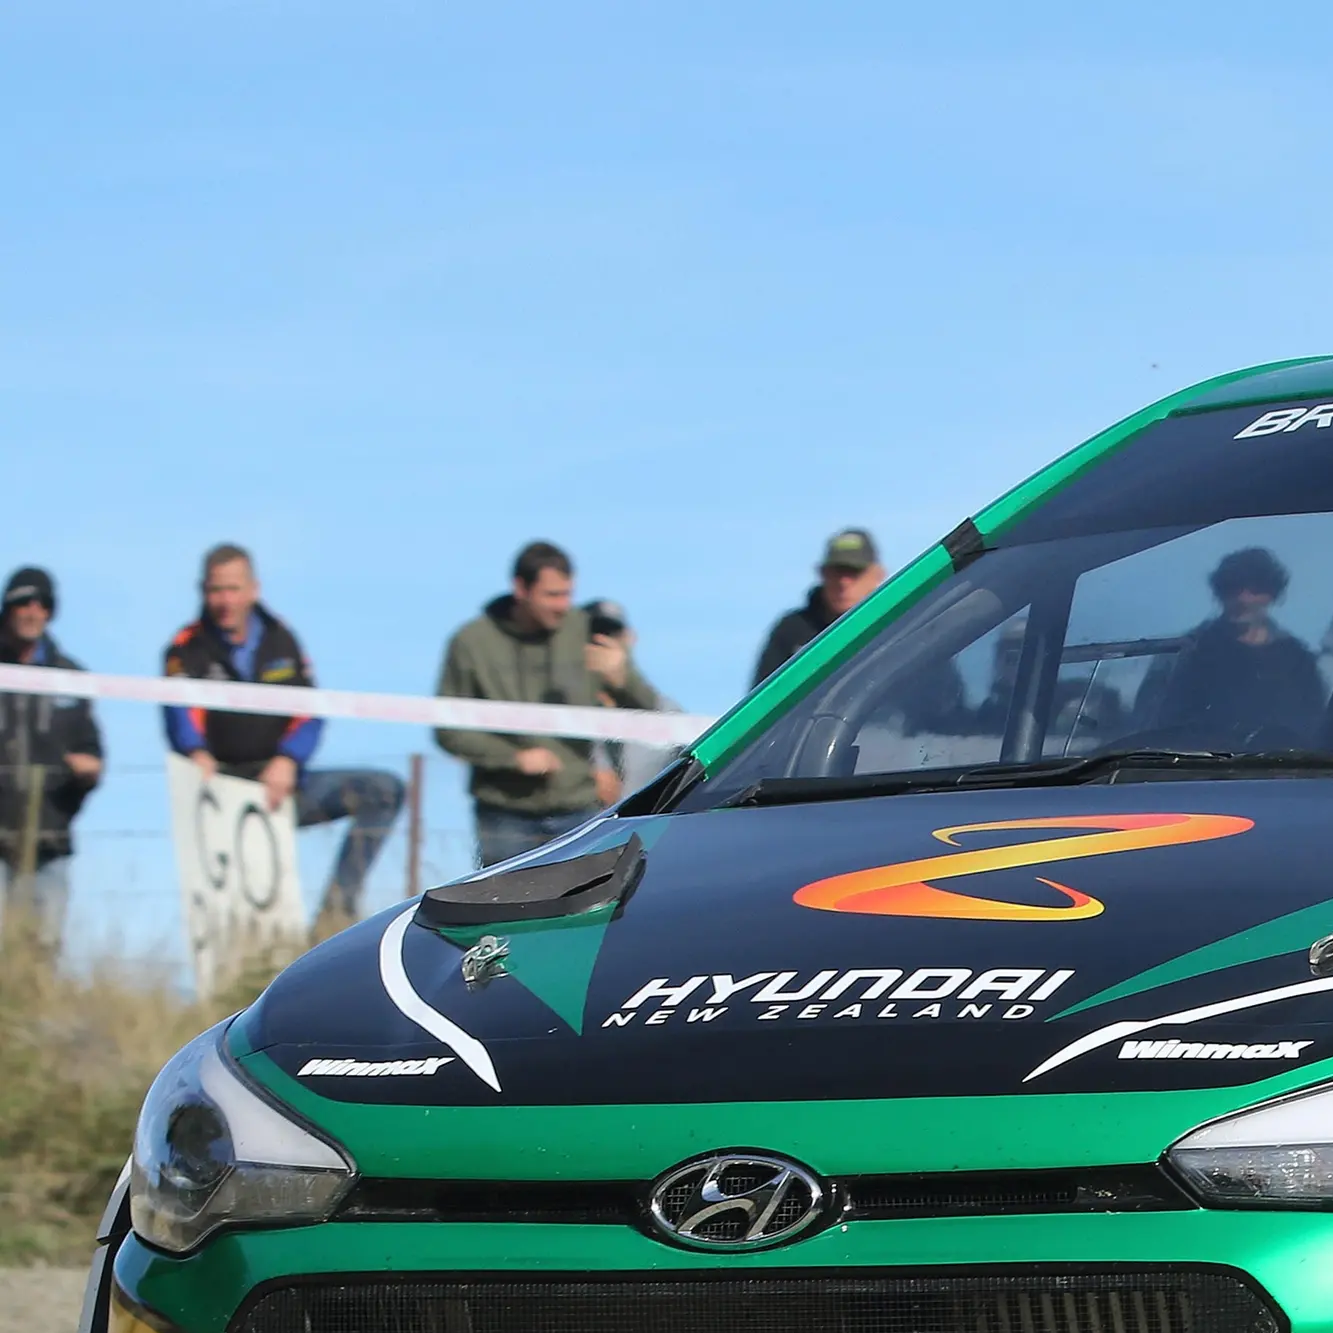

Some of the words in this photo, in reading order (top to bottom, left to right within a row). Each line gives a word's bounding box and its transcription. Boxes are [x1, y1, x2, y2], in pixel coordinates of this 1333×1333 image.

[195, 783, 281, 912] GO
[620, 968, 1076, 1010] HYUNDAI
[601, 1006, 728, 1028] NEW
[757, 1002, 1036, 1021] ZEALAND
